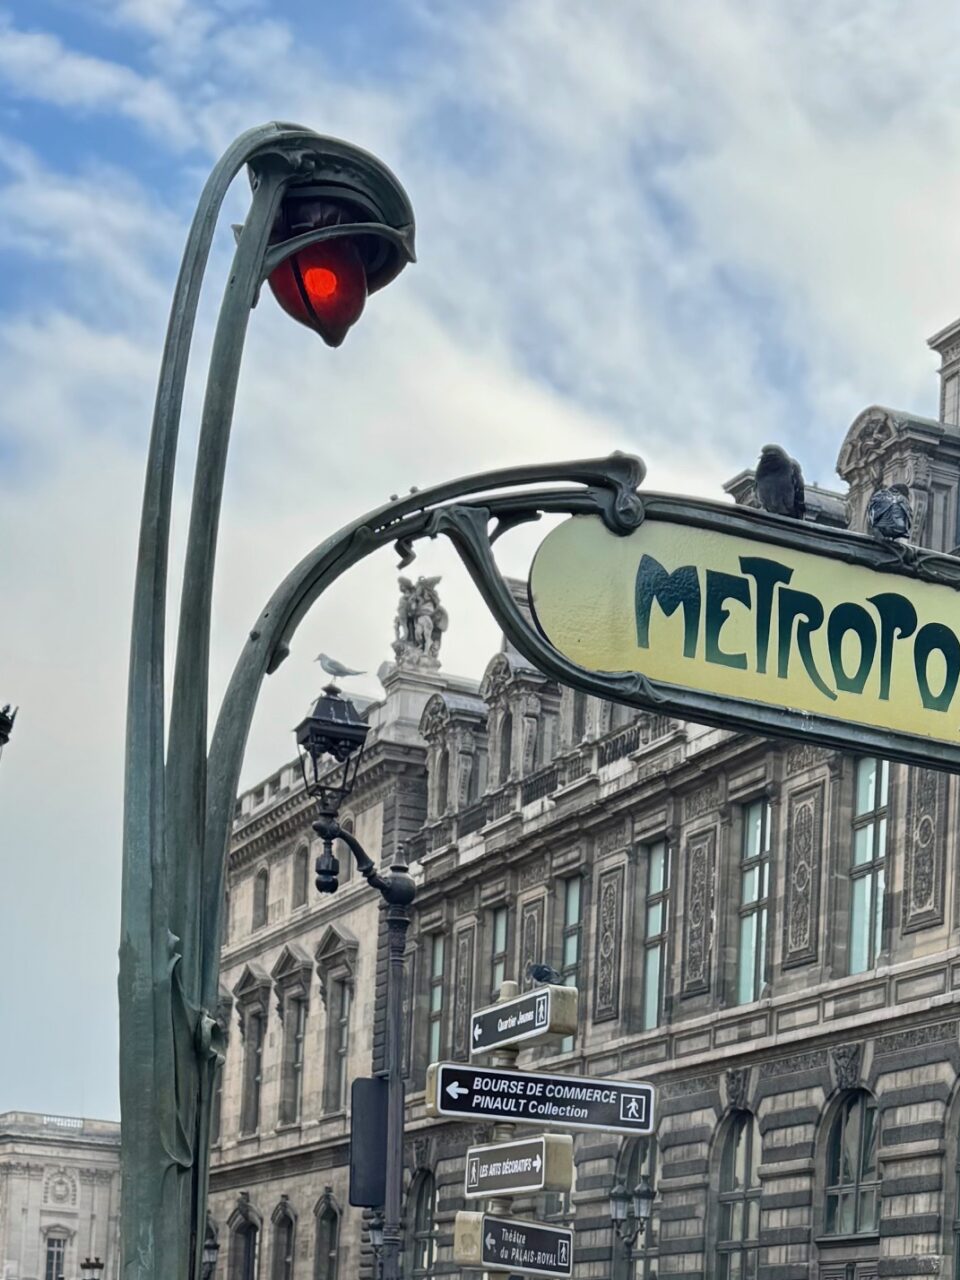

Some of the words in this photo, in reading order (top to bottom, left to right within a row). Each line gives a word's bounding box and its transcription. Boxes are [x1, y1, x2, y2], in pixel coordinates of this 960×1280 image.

[473, 1077, 525, 1095] BOURSE
[526, 1083, 543, 1097] DE
[545, 1084, 617, 1104] COMMERCE
[472, 1095, 527, 1113] PINAULT
[528, 1100, 588, 1118] Collection
[480, 1164, 489, 1178] LES
[489, 1162, 502, 1177] ARTS
[502, 1158, 532, 1175] DÉCORATIFS
[501, 1228, 526, 1245] Théâtre
[500, 1247, 509, 1260] du
[511, 1248, 557, 1267] PALAIS-ROYAL
